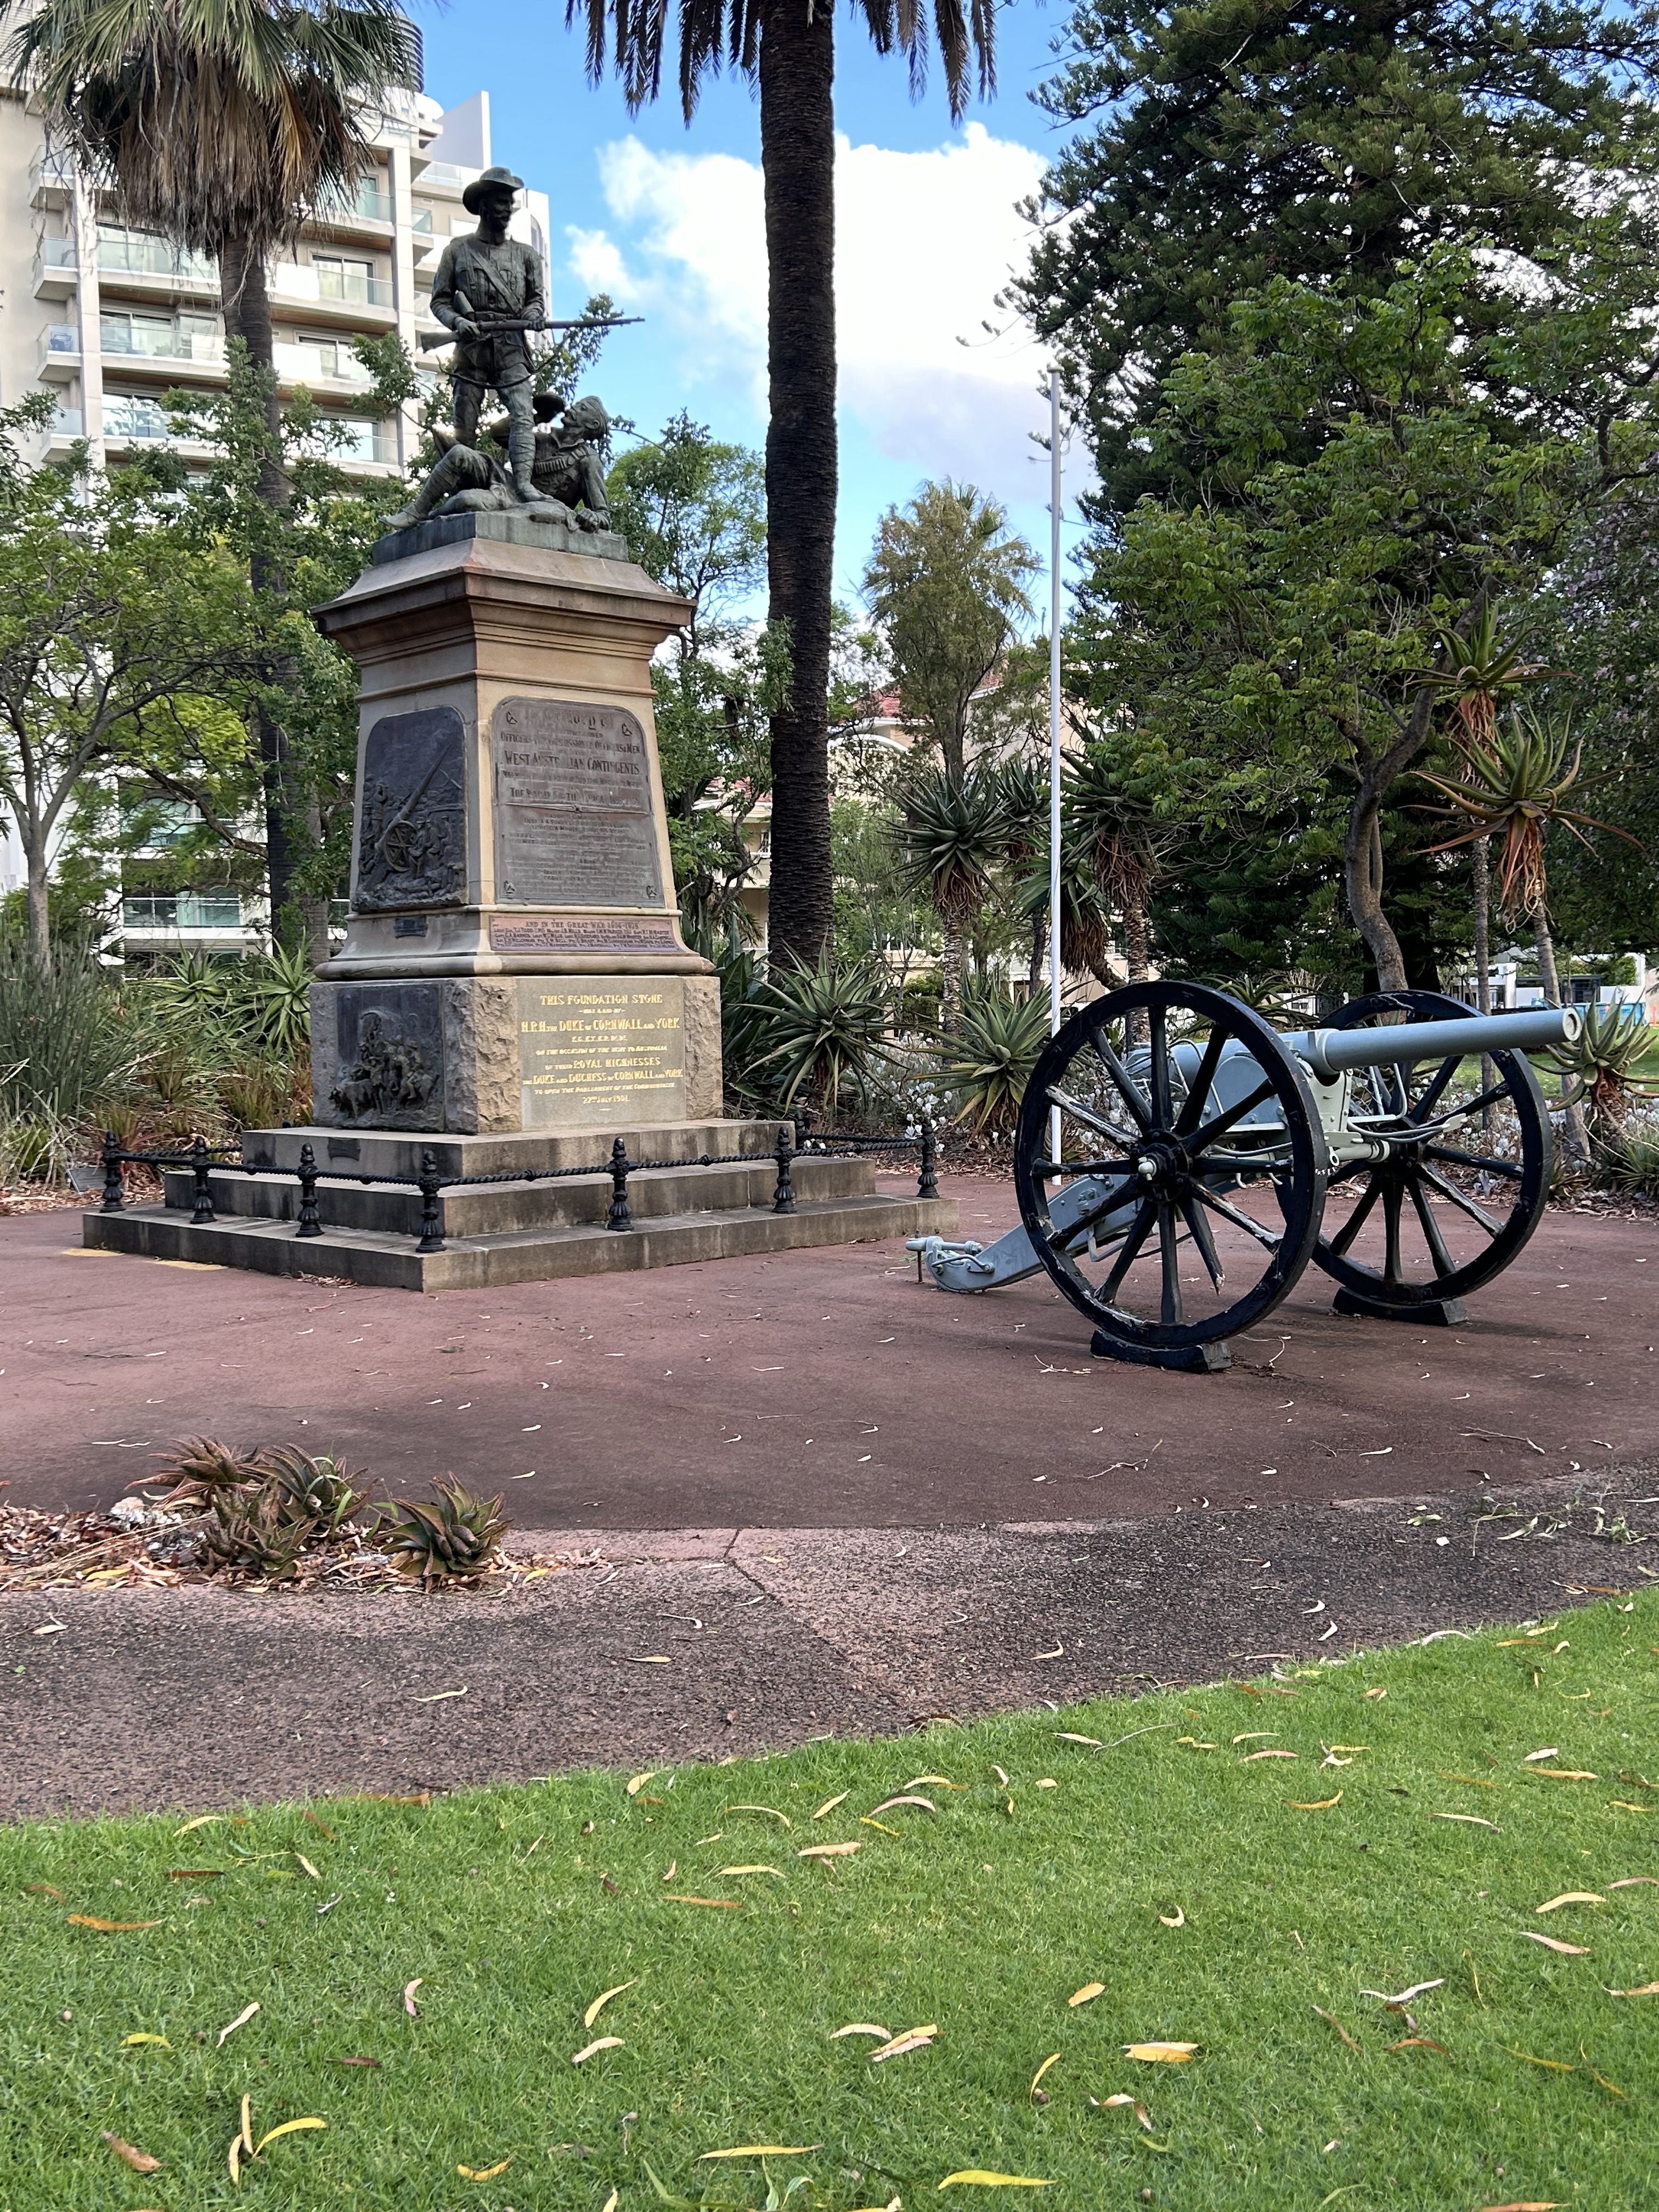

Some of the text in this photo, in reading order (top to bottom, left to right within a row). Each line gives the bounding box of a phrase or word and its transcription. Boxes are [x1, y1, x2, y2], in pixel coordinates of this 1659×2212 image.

[504, 750, 531, 766] WEST
[587, 757, 640, 775] CONTINGENTS
[540, 994, 663, 1005] THIS FOUNDATION STONE
[559, 1019, 585, 1032] DUKE
[593, 1018, 641, 1031] CORNWALL
[654, 1017, 680, 1029] YORK
[573, 1059, 602, 1069] ROYAL
[605, 1057, 661, 1068] HIGHNESSES
[533, 1074, 555, 1085] DUKE
[569, 1072, 607, 1083] DUCHESS
[614, 1070, 654, 1080] CORNWALL
[664, 1069, 684, 1079] YORK
